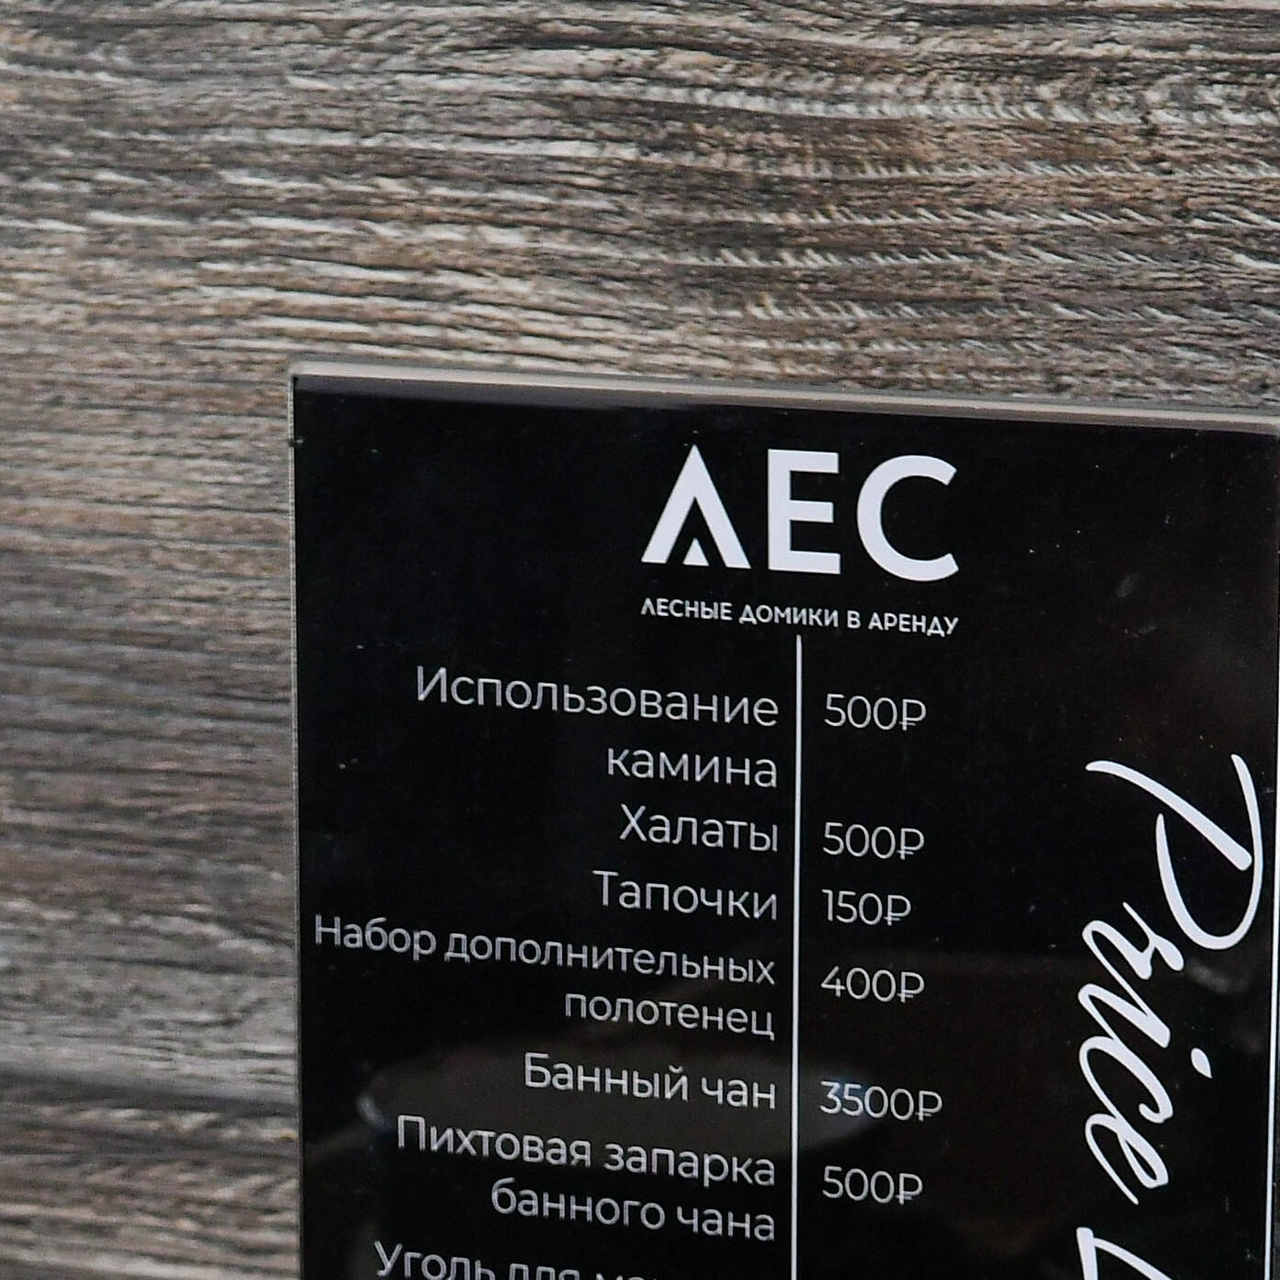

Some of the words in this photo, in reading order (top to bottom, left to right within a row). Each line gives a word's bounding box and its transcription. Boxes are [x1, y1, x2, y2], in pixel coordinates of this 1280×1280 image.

[640, 597, 733, 621] ЛЕСНЫЕ
[738, 604, 839, 628] ДОМИКИ
[846, 609, 862, 630] В
[867, 611, 960, 638] АРЕНДУ
[417, 665, 779, 727] Использование
[608, 747, 778, 788] камина
[619, 804, 778, 853] Халаты
[592, 870, 777, 921] Тапочки
[314, 915, 437, 962] Набор
[444, 933, 776, 985] дополнительных
[1078, 755, 1262, 1204] Price
[565, 993, 776, 1042] полотенец
[524, 1052, 689, 1102] Банный
[701, 1077, 776, 1110] чан
[397, 1115, 592, 1167] Пихтовая
[604, 1144, 775, 1188] запарка
[492, 1177, 666, 1230] банного
[677, 1206, 775, 1242] чана
